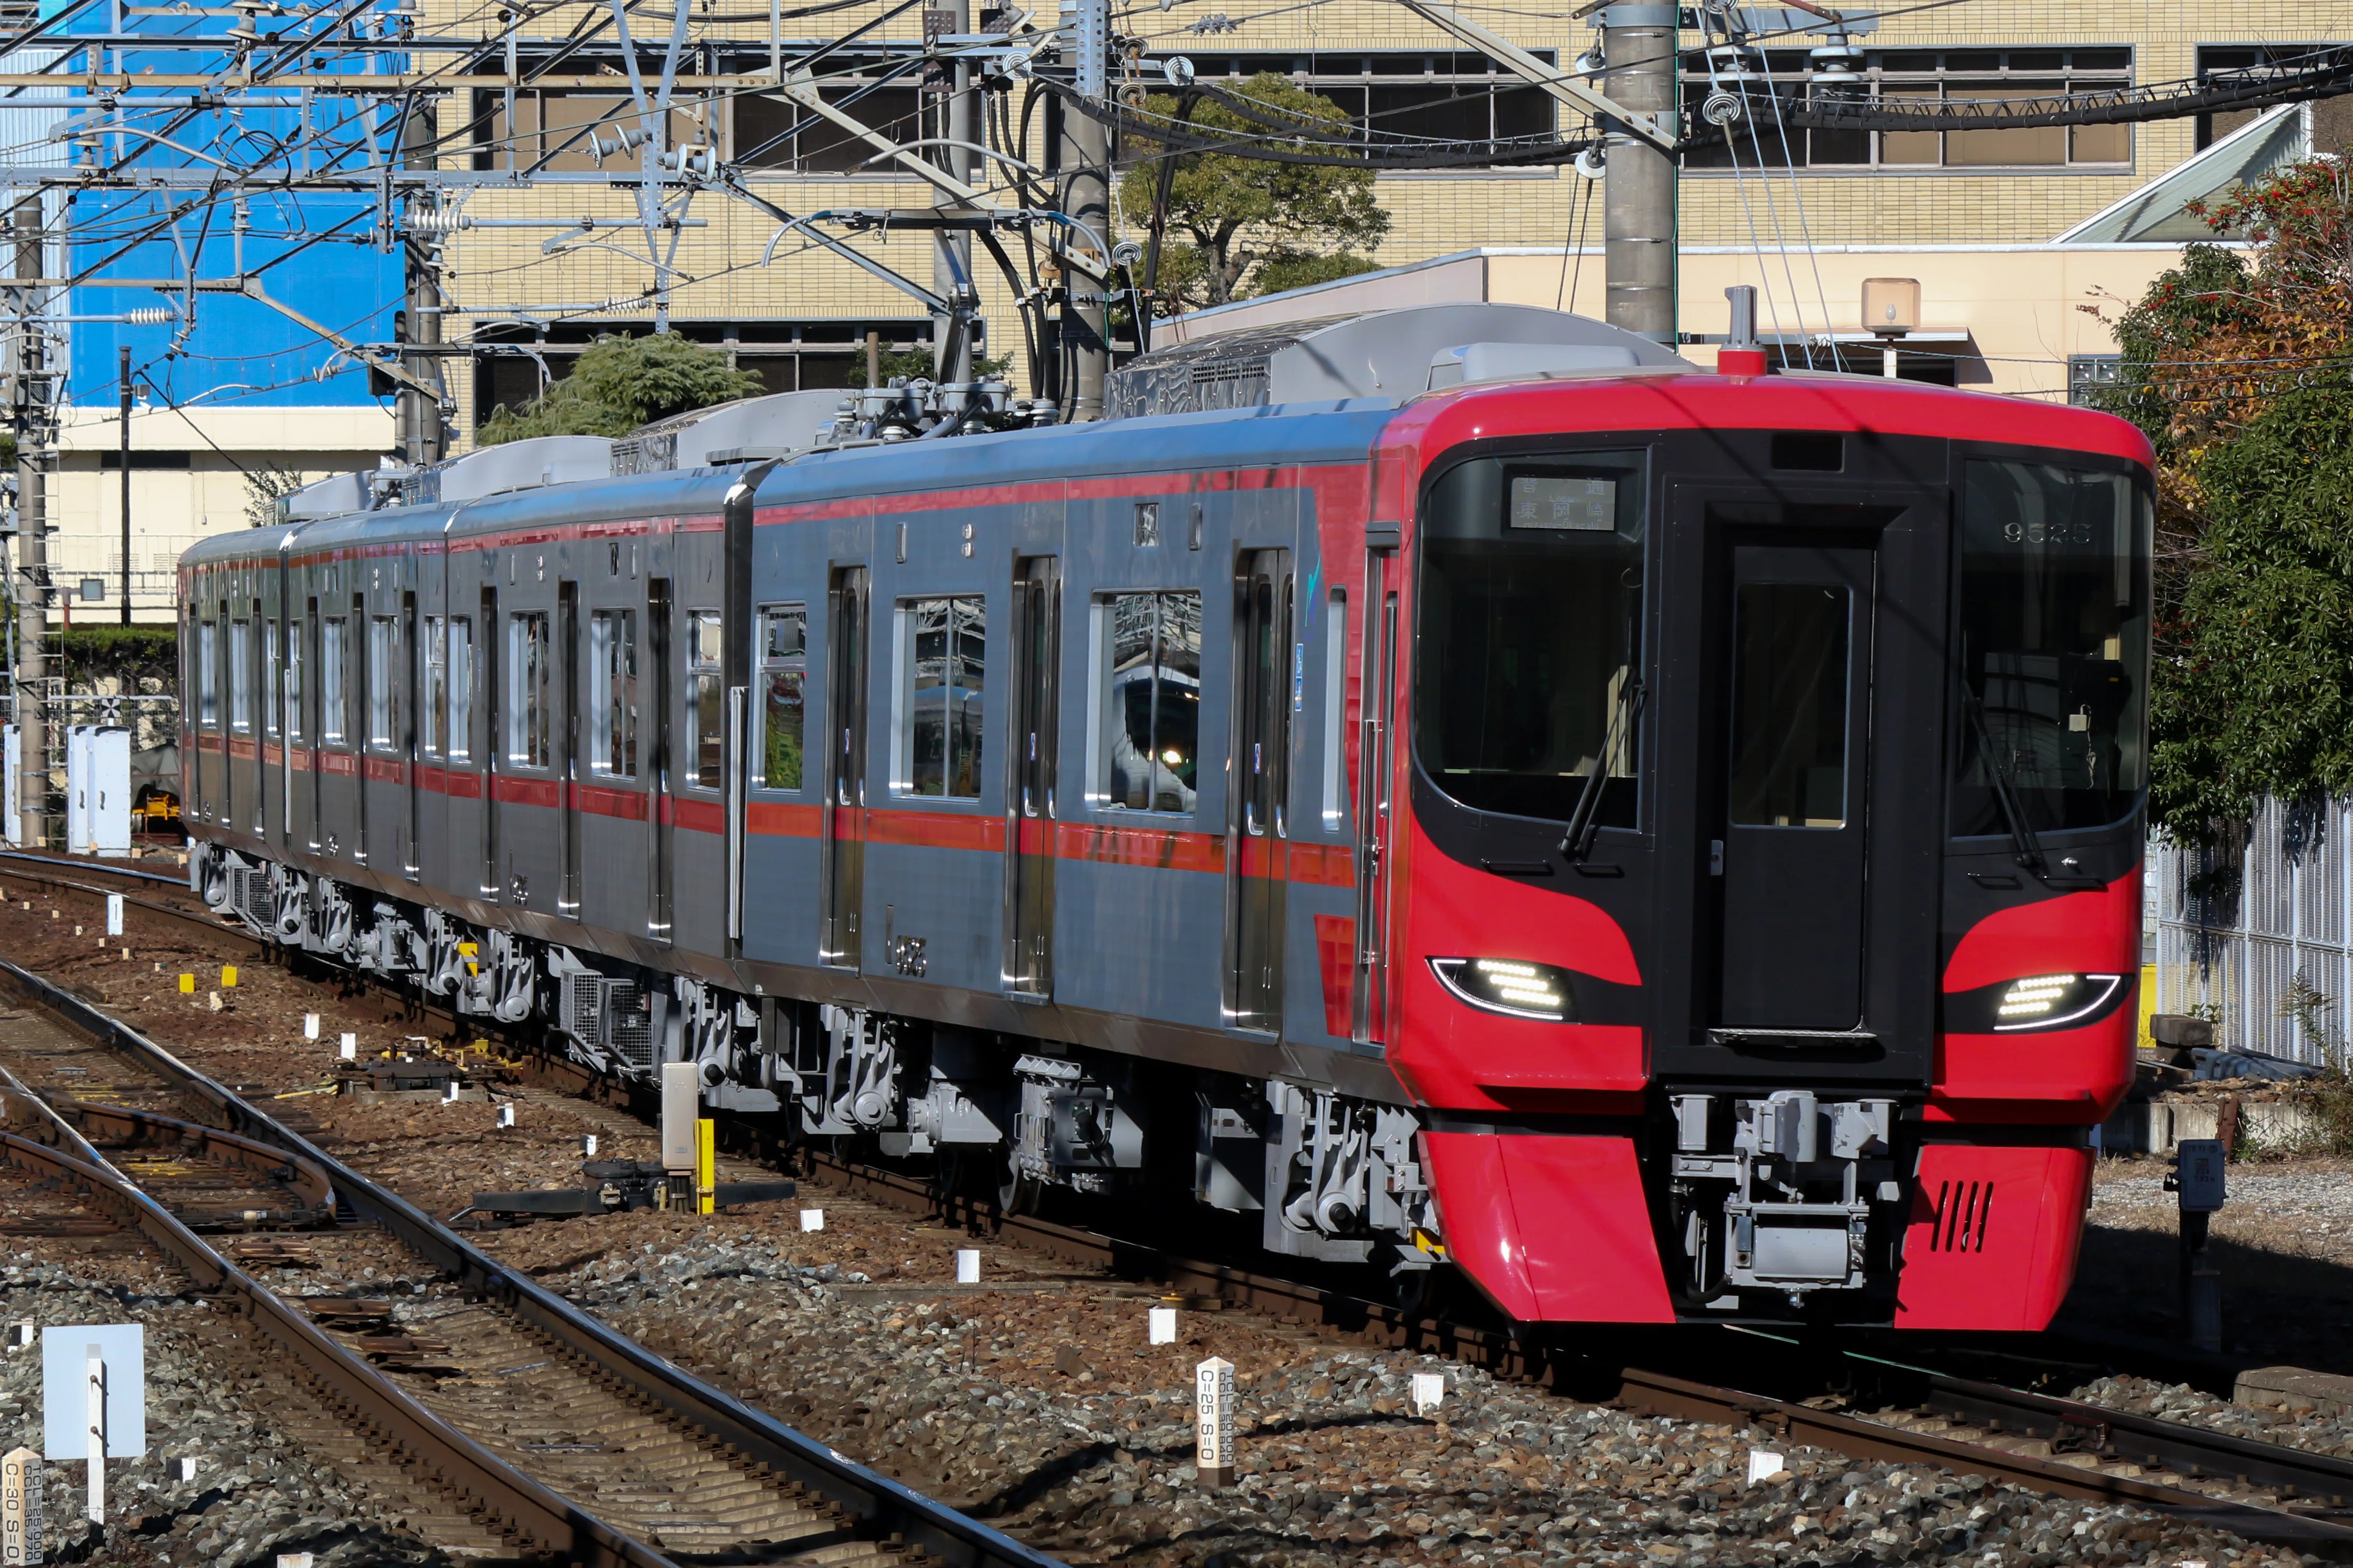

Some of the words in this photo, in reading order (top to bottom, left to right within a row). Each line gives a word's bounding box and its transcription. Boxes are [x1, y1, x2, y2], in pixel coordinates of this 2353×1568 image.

[1520, 501, 1603, 520] 東岡崎
[2005, 522, 2092, 544] 9525
[1201, 1370, 1214, 1414] C=25
[6, 1463, 19, 1511] C=30
[24, 1465, 33, 1561] CCL=35.770
[33, 1464, 42, 1560] TCL=25.000
